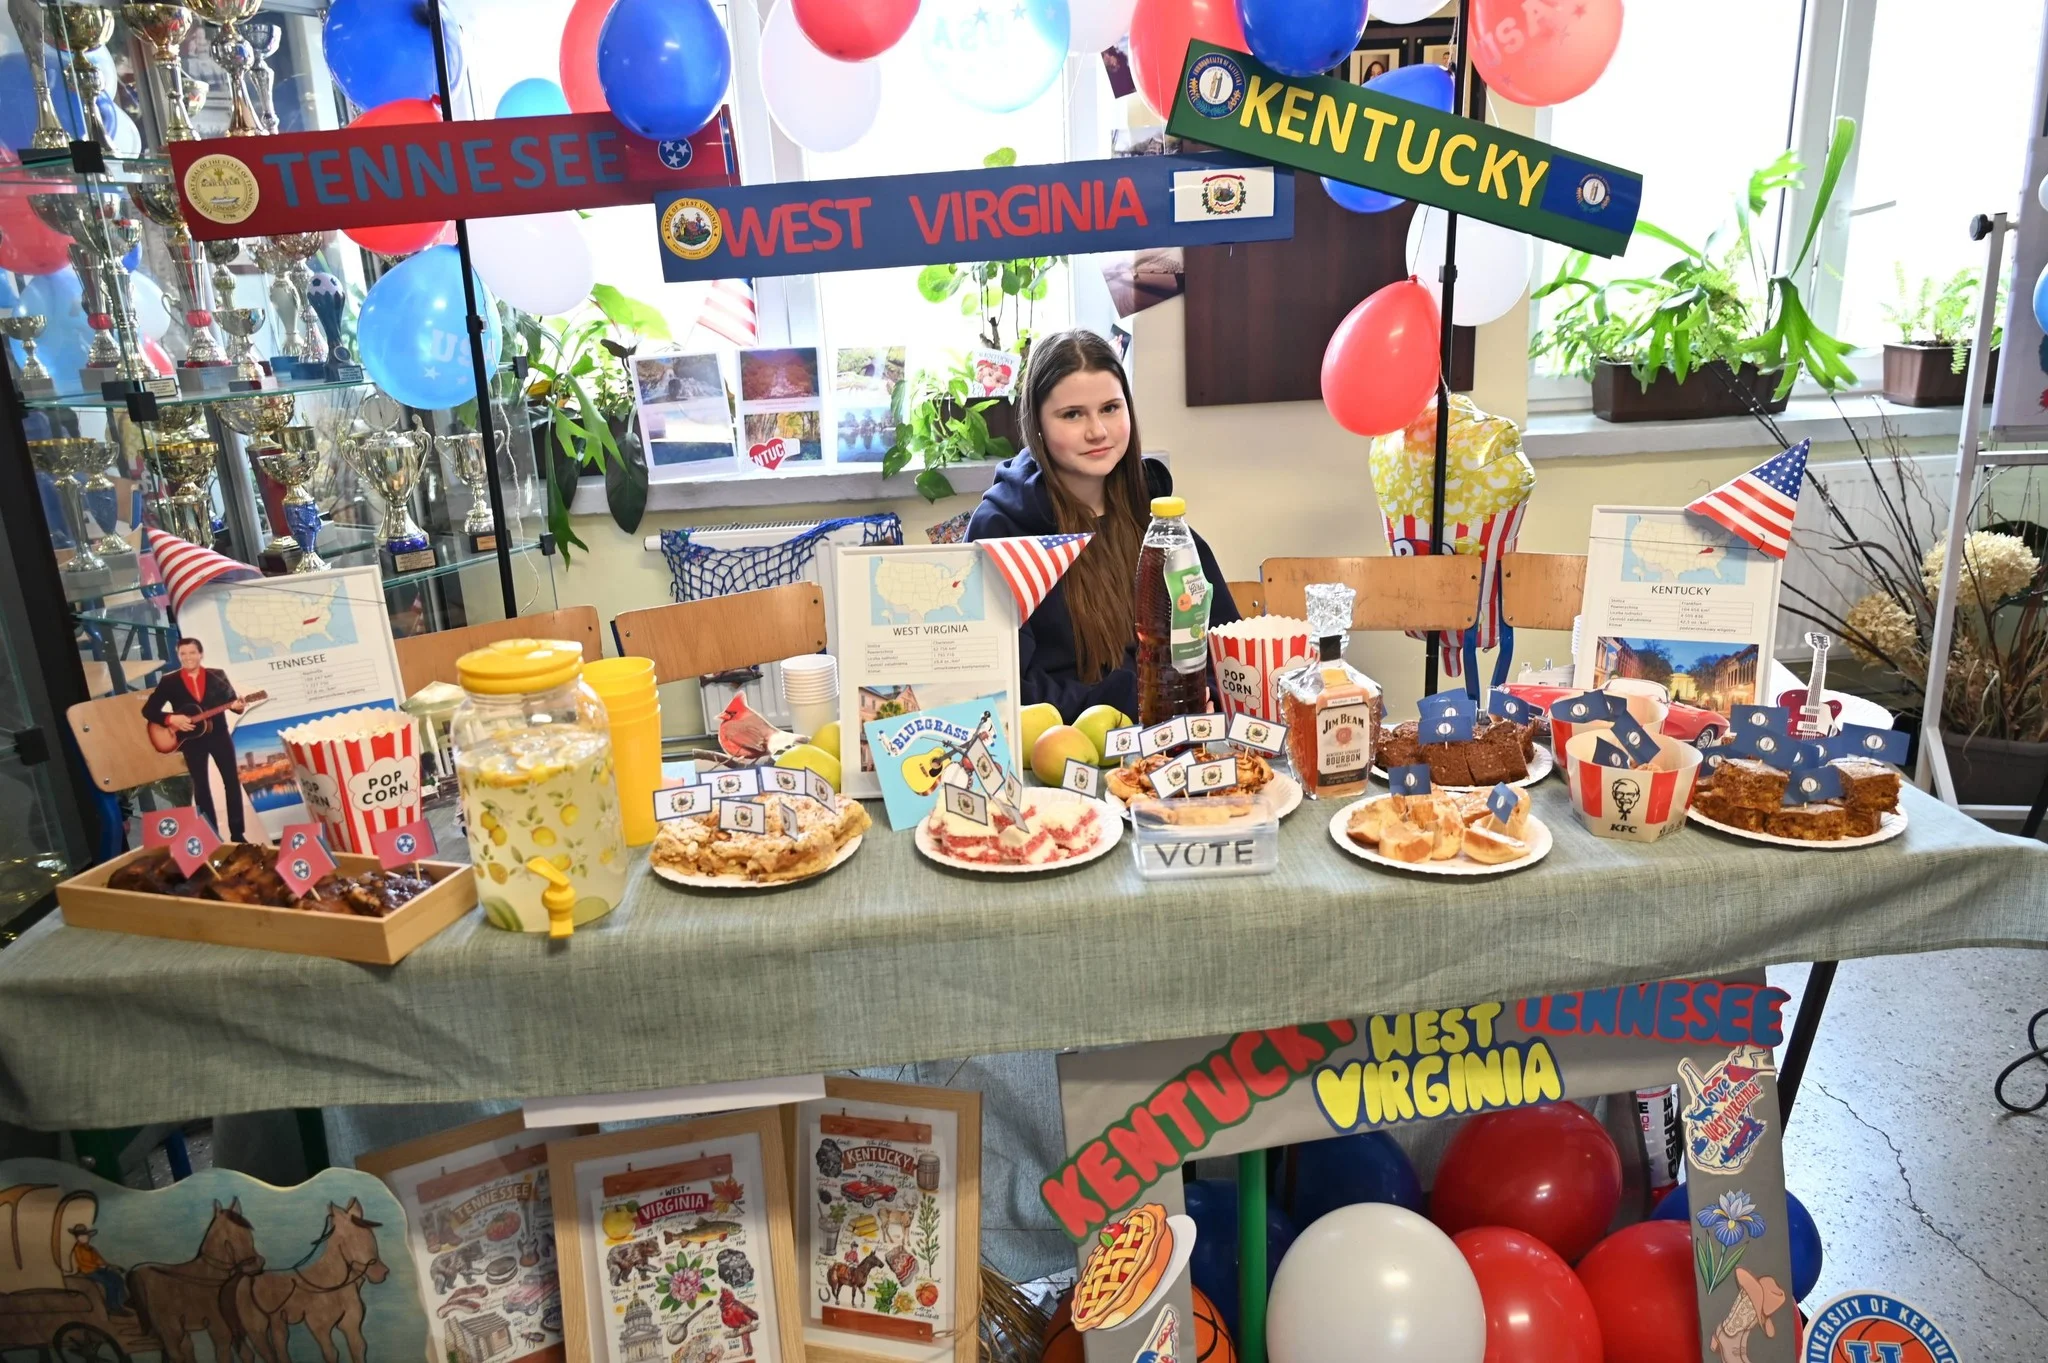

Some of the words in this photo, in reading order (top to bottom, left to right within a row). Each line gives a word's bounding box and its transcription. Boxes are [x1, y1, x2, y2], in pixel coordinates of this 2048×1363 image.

[1238, 75, 1549, 207] KENTUCKY
[263, 131, 625, 207] TENNESEE
[664, 212, 674, 231] STATE
[699, 203, 718, 230] VIRGINIA
[718, 196, 872, 258] WEST
[909, 176, 1149, 245] VIRGINIA
[1651, 585, 1712, 596] KENTUCKY
[893, 627, 920, 637] WEST
[924, 624, 969, 636] VIRGINIA
[268, 653, 327, 672] TENNESEE
[1222, 679, 1252, 695] CORN
[1224, 669, 1245, 682] POP
[893, 718, 969, 750] BLUEGRASS
[1322, 719, 1339, 735] JIM
[1340, 713, 1364, 728] BEAM
[1326, 753, 1361, 766] BOURBON
[368, 770, 402, 790] POP
[362, 781, 409, 805] CORN
[1610, 823, 1638, 834] KFC
[1154, 839, 1254, 868] VOTE
[1370, 1001, 1502, 1061] WEST
[1316, 1042, 1562, 1129] VIRGINIA
[1663, 1095, 1680, 1180] OSHEE
[846, 1147, 912, 1169] KENTUCKY
[454, 1184, 529, 1218] TENNESSEE
[665, 1186, 685, 1196] WEST
[641, 1194, 705, 1220] VIRGINIA
[1870, 1298, 1889, 1314] OF
